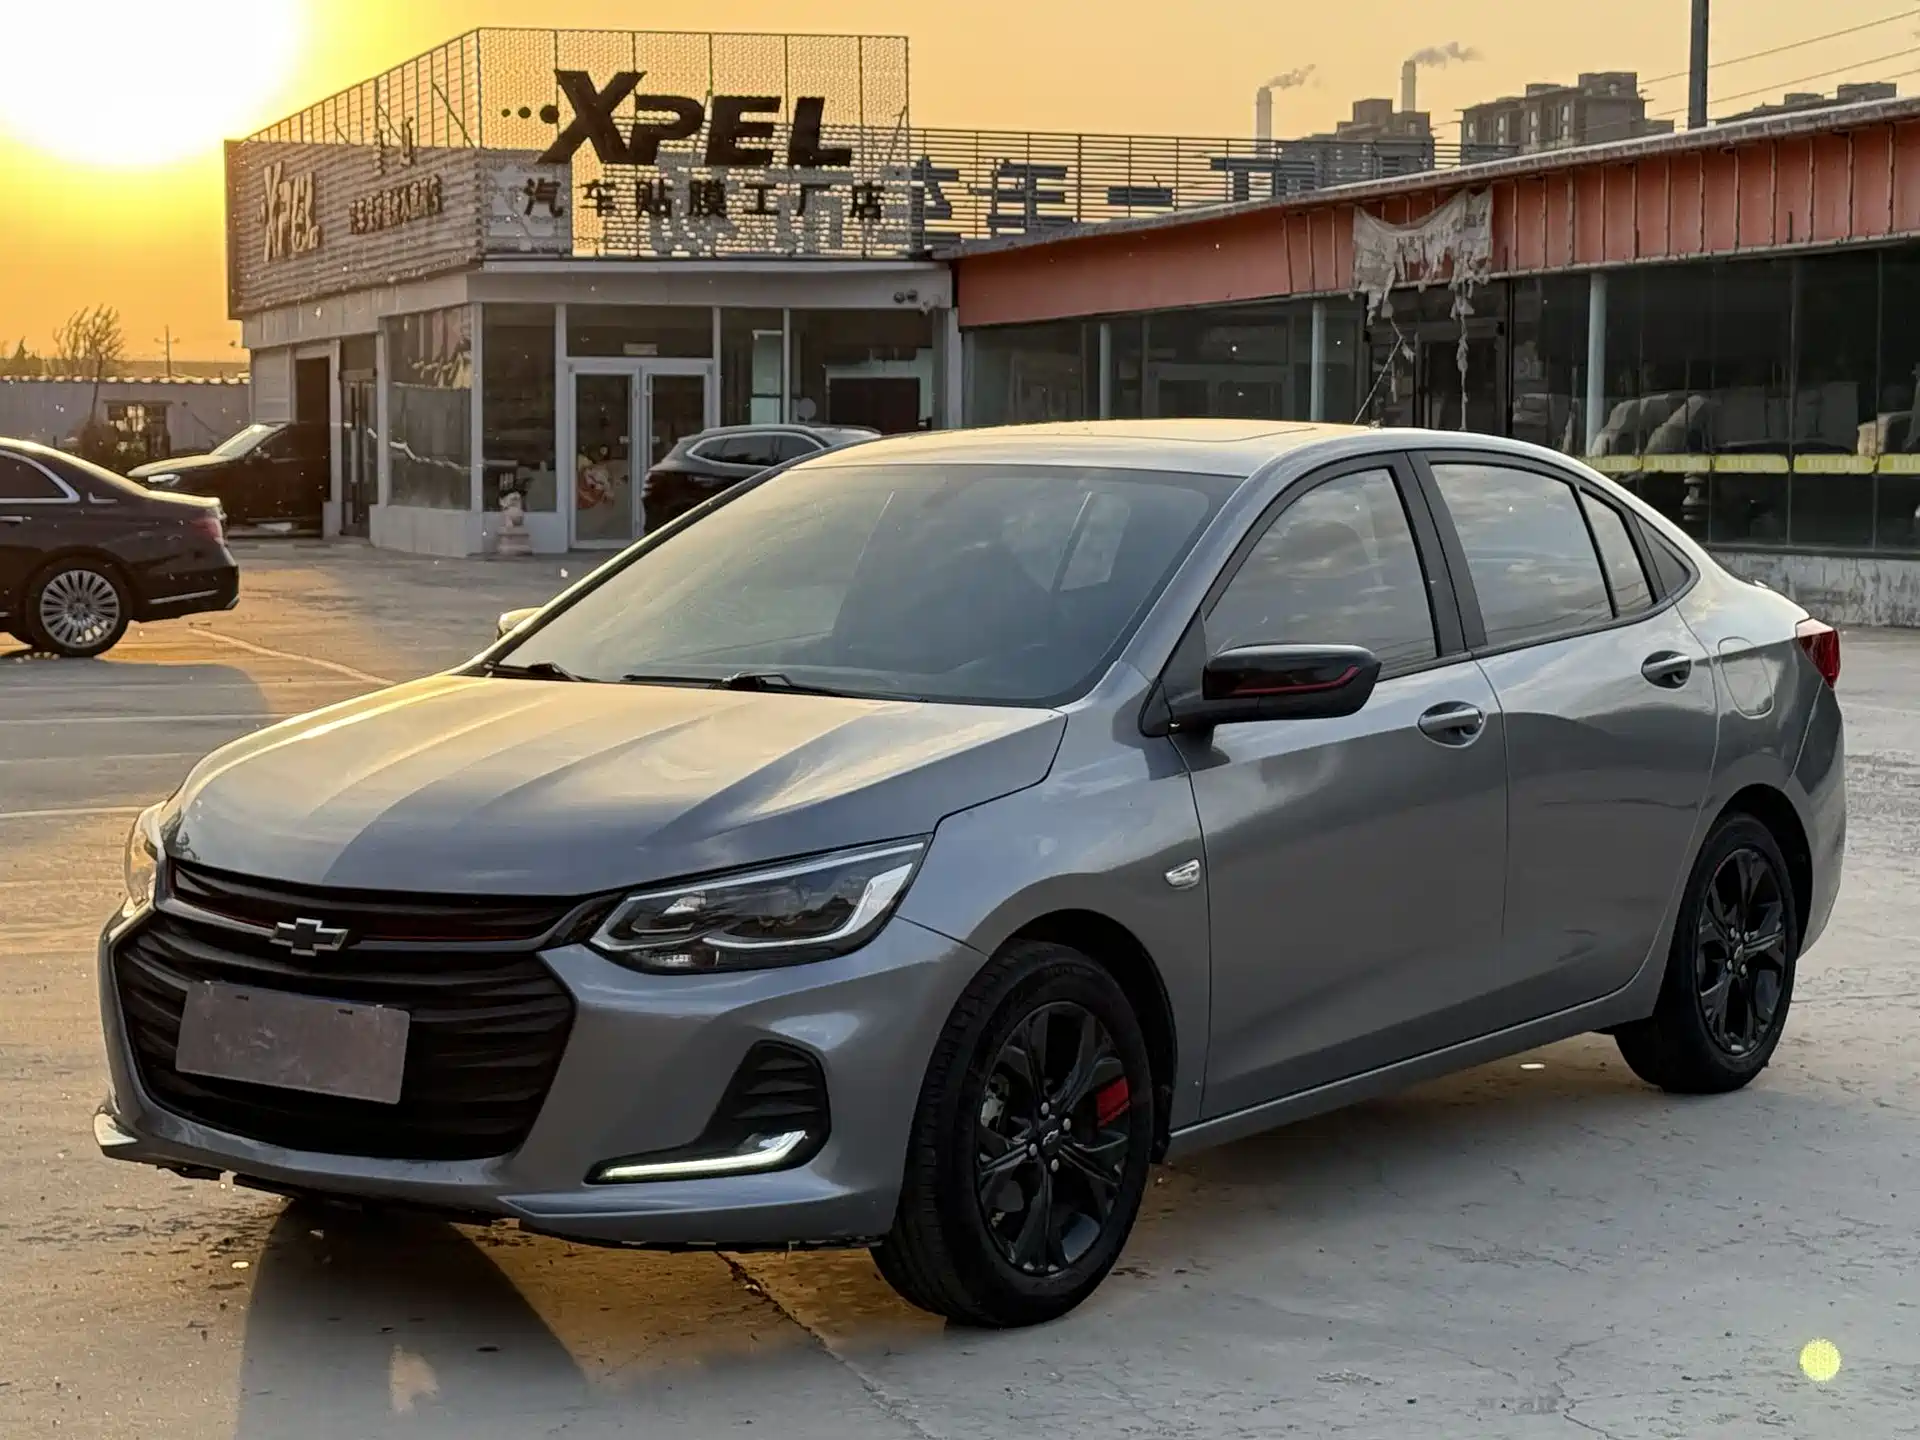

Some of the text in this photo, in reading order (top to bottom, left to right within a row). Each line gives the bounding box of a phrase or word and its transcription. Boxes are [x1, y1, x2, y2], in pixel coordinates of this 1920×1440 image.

[534, 69, 853, 167] XPEL
[523, 177, 885, 219] 汽车贴膜工厂店
